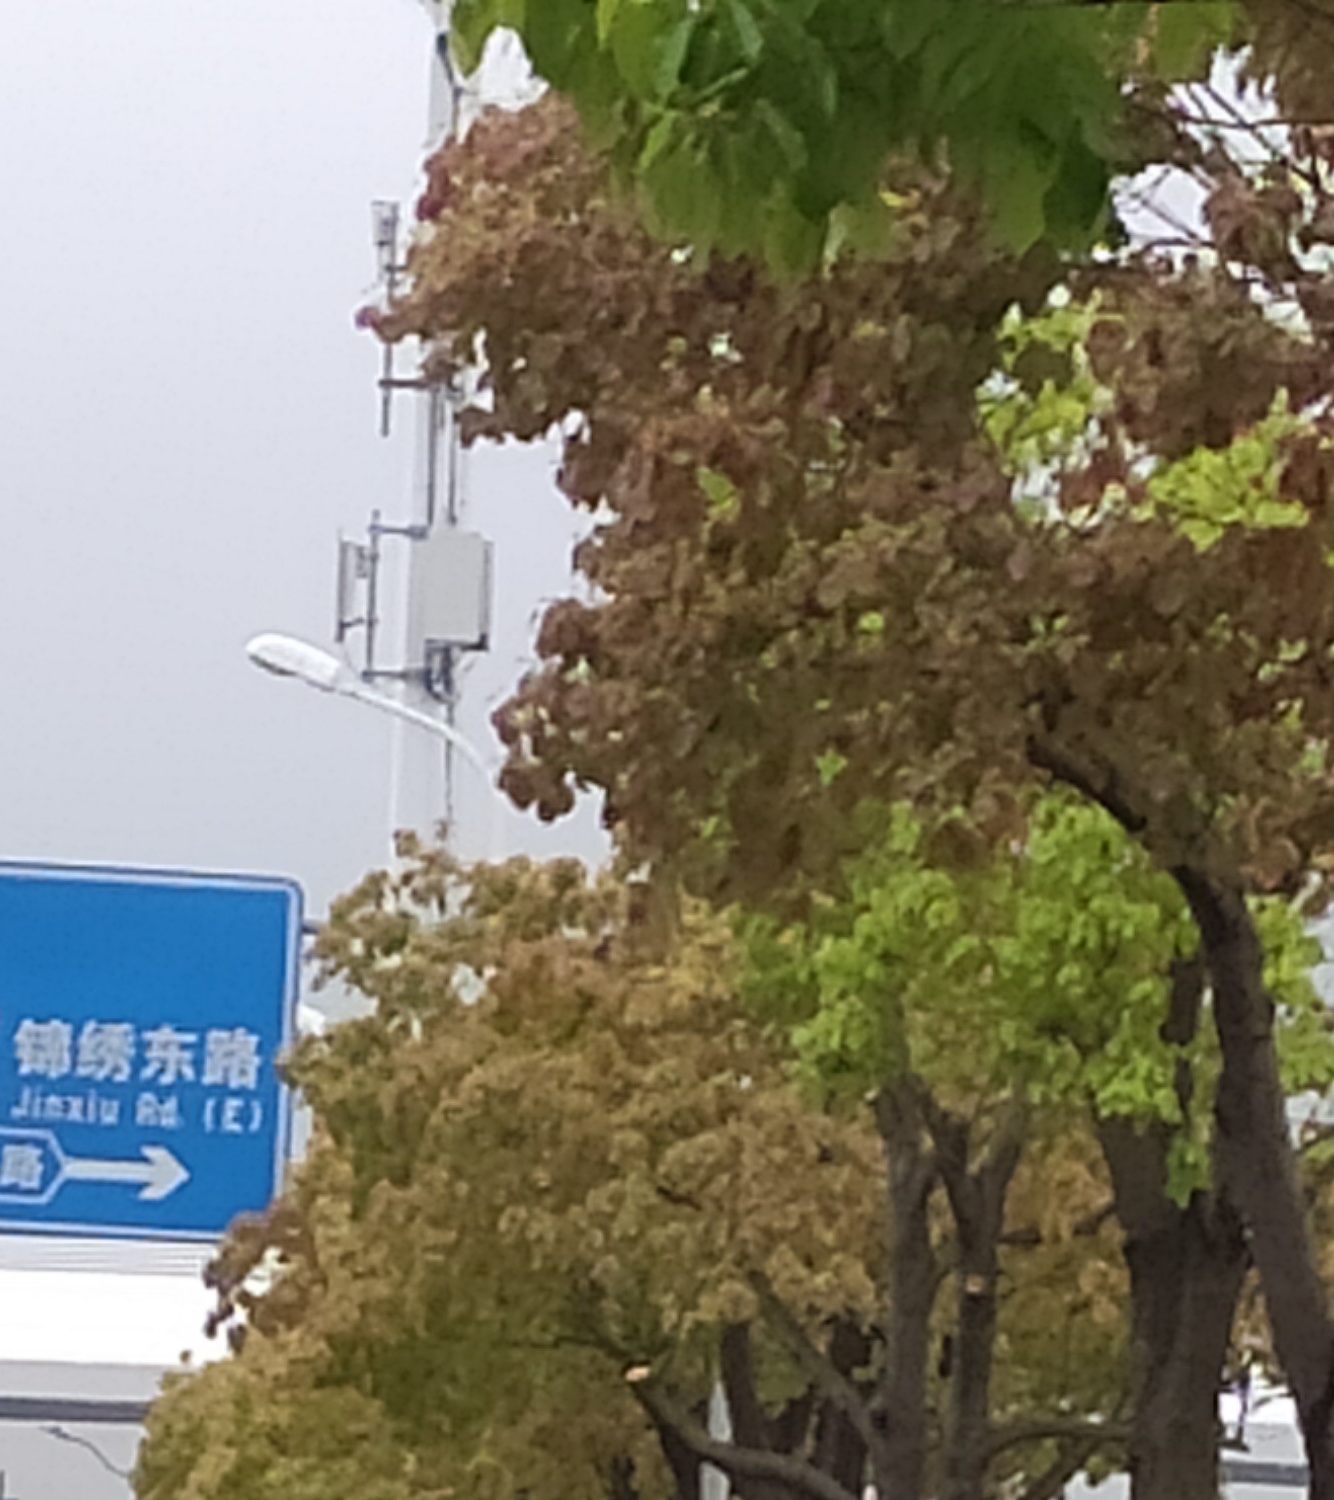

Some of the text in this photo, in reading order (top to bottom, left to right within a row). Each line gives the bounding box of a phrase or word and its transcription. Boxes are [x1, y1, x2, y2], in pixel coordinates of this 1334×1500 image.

[14, 1018, 260, 1089] 锦绣东路
[10, 1085, 263, 1134] Jinxiu Rd (E)
